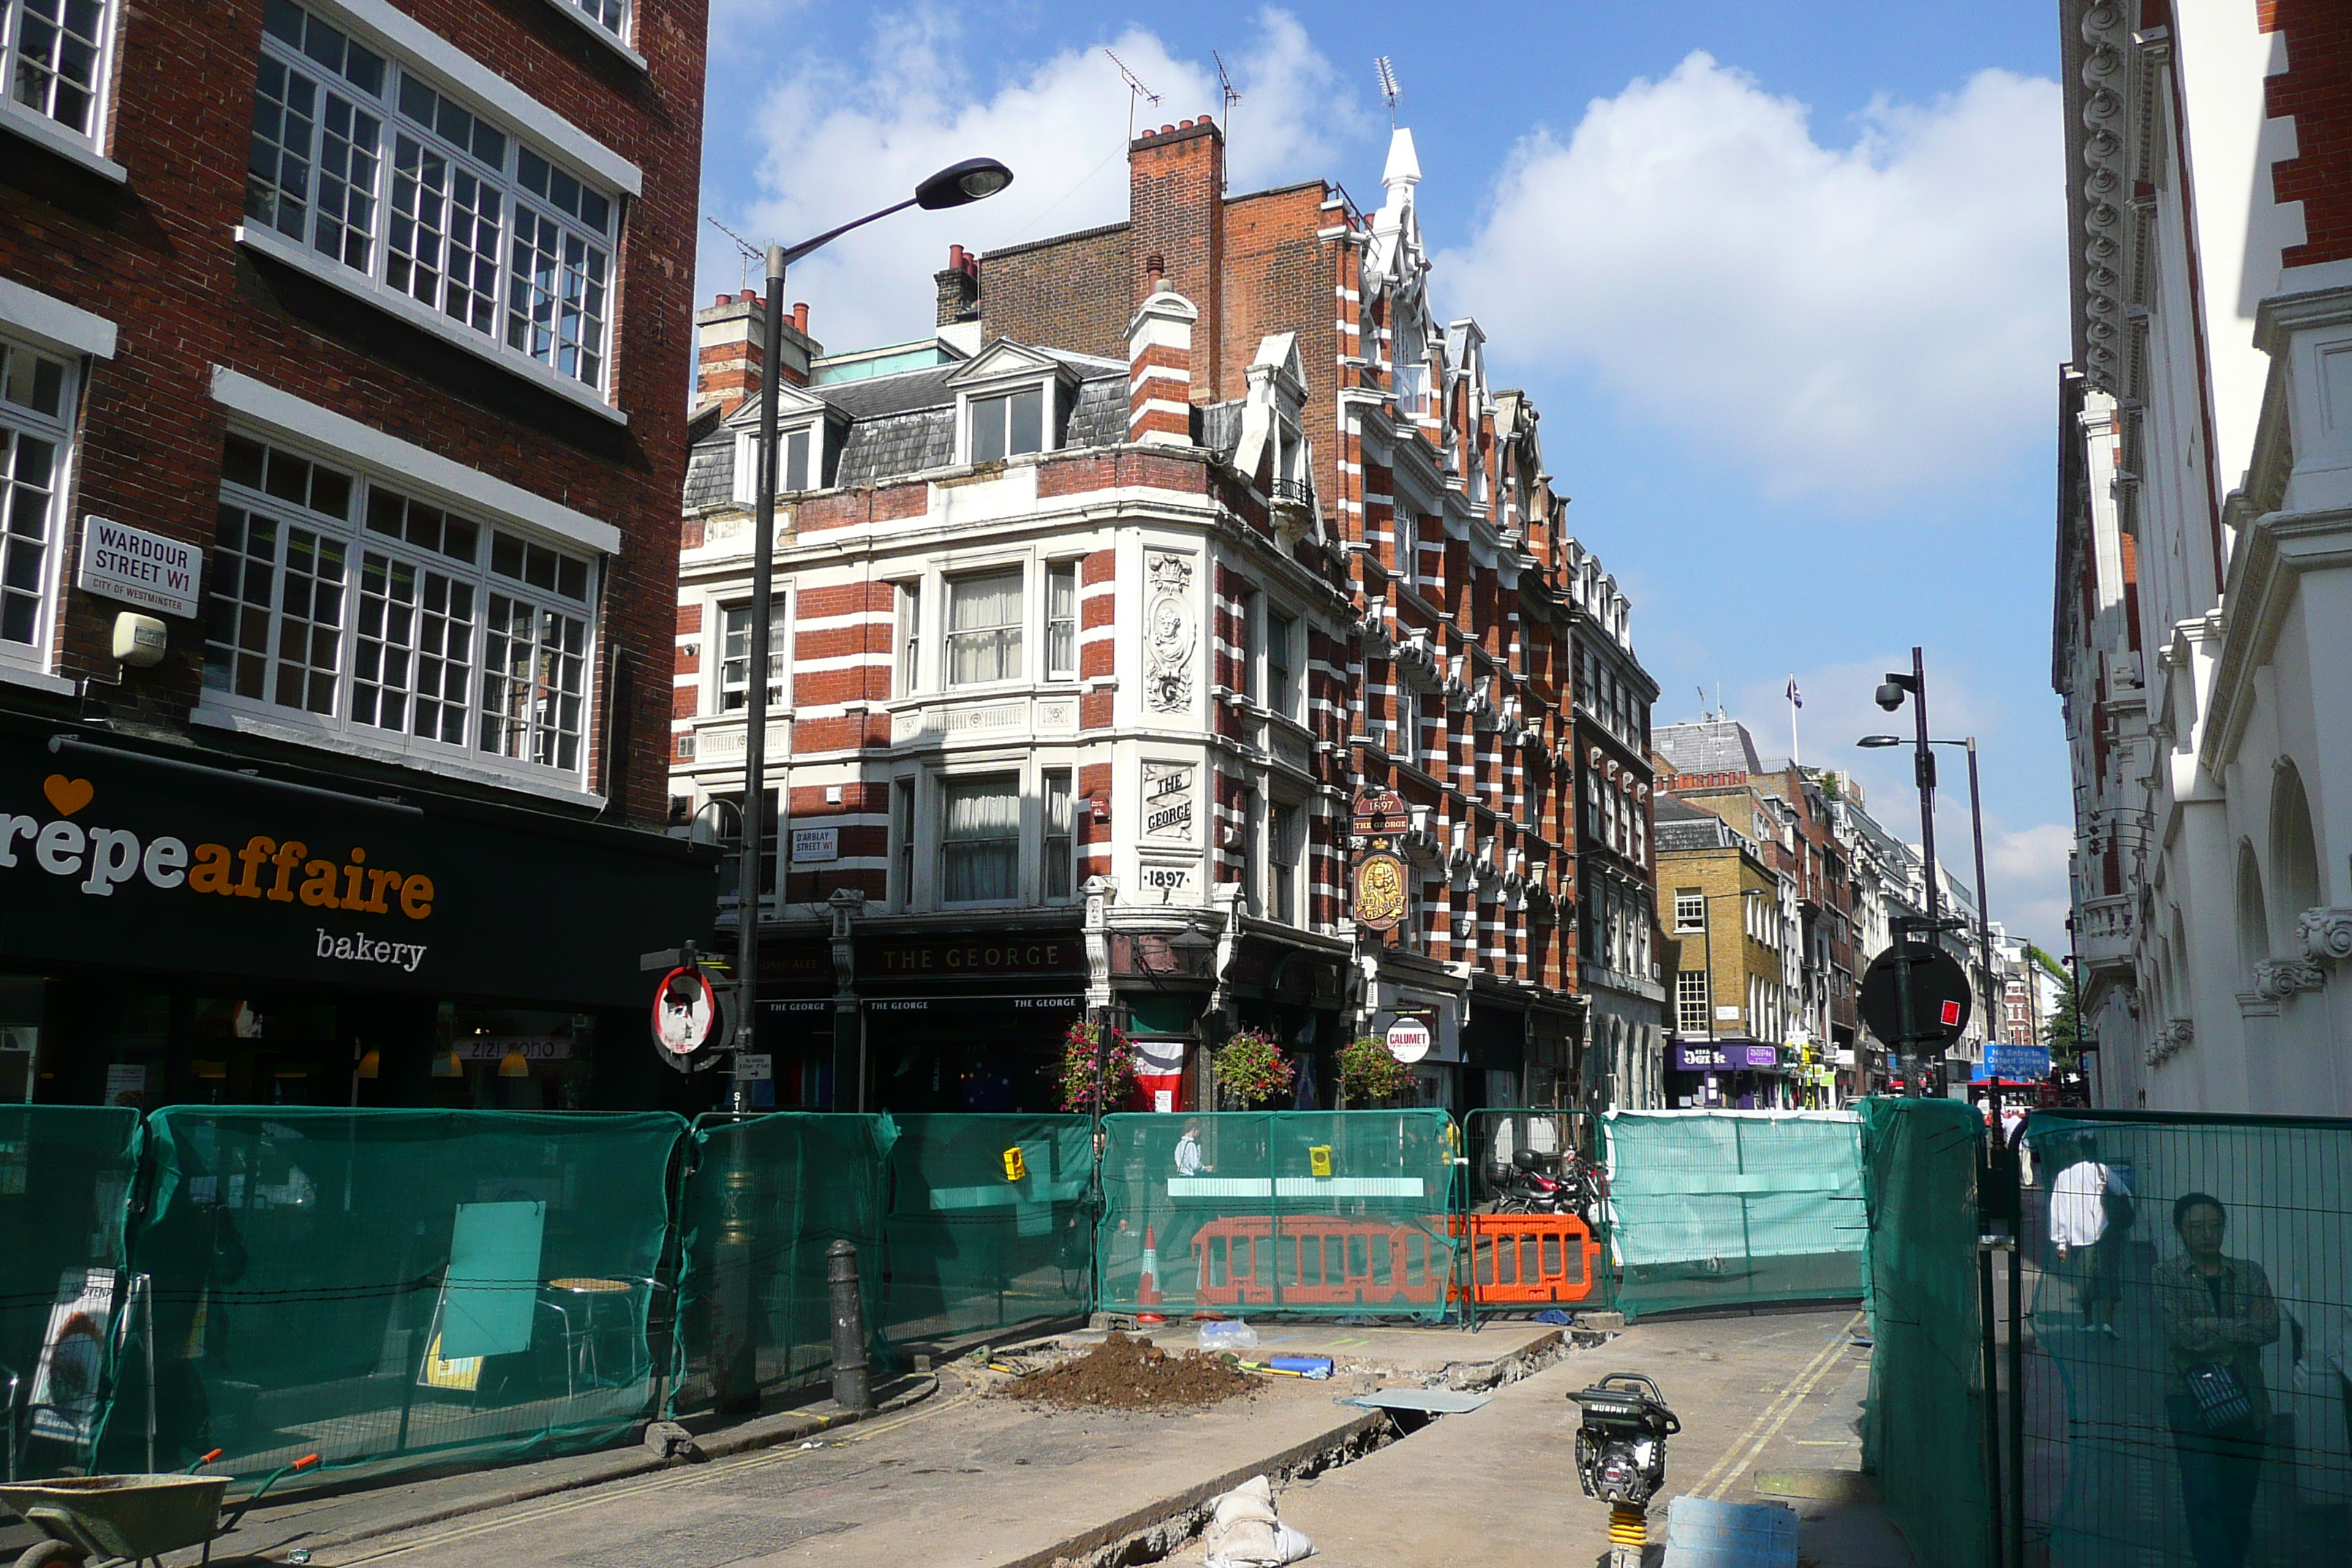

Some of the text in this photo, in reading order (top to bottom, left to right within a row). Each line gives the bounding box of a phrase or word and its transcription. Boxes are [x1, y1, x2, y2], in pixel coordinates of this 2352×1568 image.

[99, 526, 188, 569] WARDOUR
[96, 549, 189, 592] STREET W1
[93, 578, 182, 611] CITY OF WESTMINSTER
[1157, 774, 1182, 794] THE
[1369, 801, 1394, 811] 1897
[1148, 802, 1191, 829] GEORGE
[1355, 821, 1406, 829] THE GEORGE
[796, 832, 829, 842] D'ARBLAY
[796, 842, 832, 851] STREET W1
[1150, 870, 1186, 889] 1897
[1357, 897, 1374, 906] THE
[1365, 897, 1402, 919] GEORGE
[316, 928, 428, 972] bakery
[794, 959, 817, 969] ALES
[883, 946, 1059, 969] THE GEORGE
[770, 1003, 825, 1011] THE GEORGE
[871, 1001, 928, 1010] THE GEORGE
[1014, 998, 1076, 1008] THE GEORGE
[1390, 1033, 1427, 1044] CALUMET
[471, 1042, 500, 1058] zizi
[1684, 1049, 1726, 1065] Jerk
[1591, 1403, 1629, 1414] MURPHY
